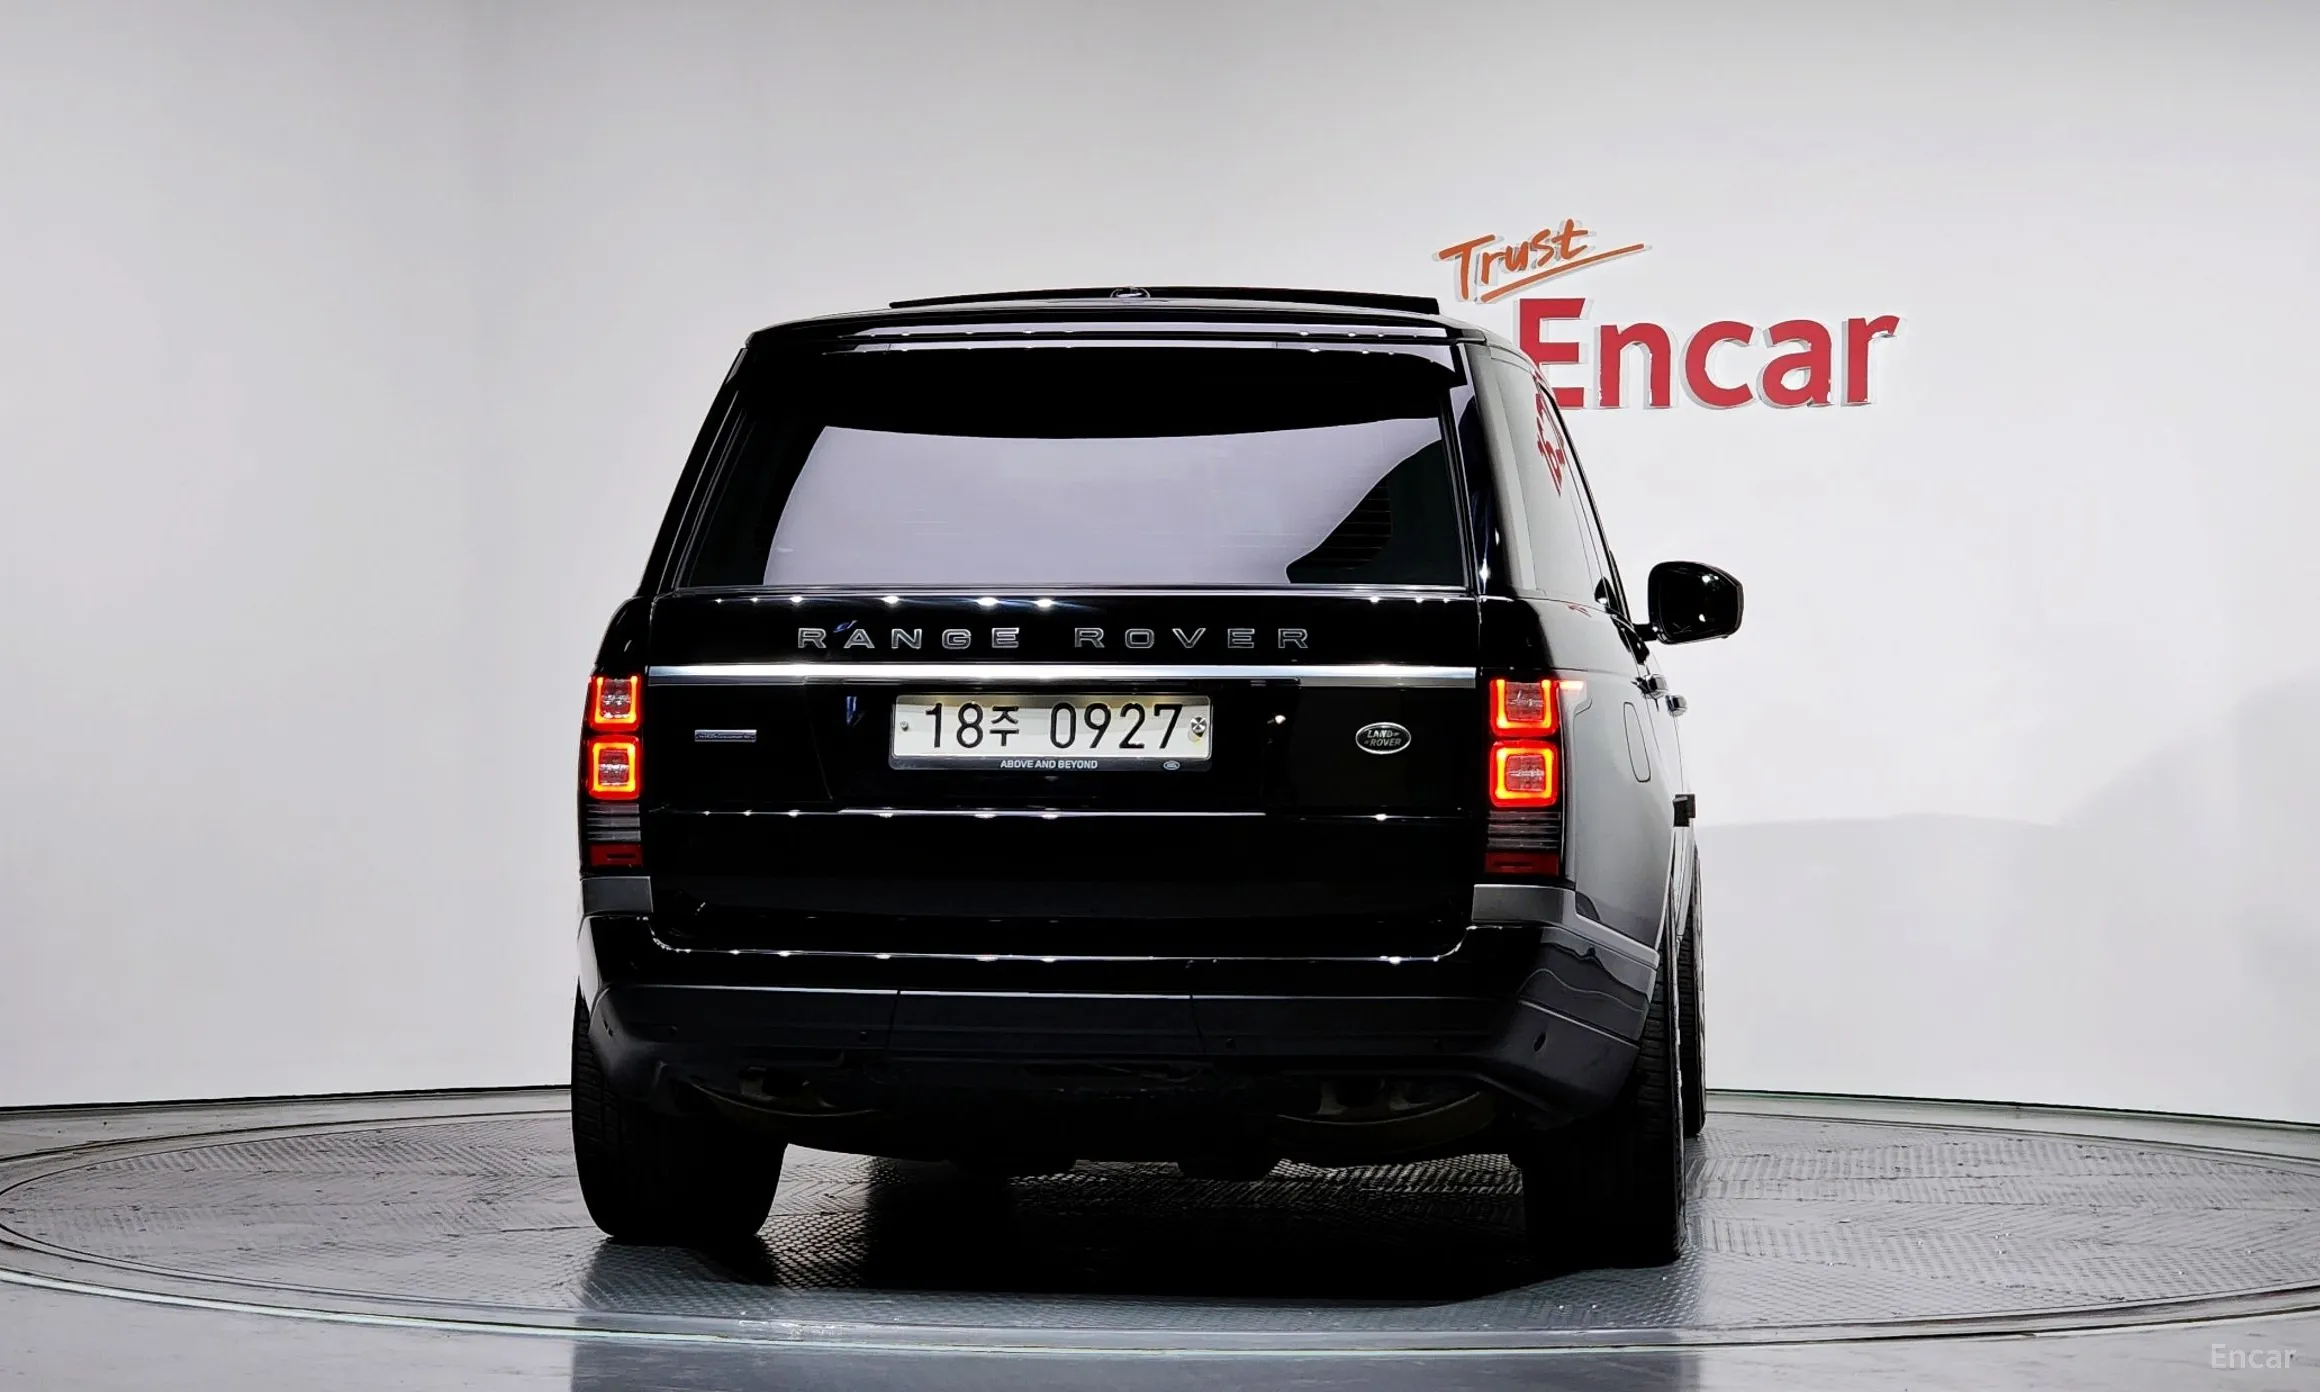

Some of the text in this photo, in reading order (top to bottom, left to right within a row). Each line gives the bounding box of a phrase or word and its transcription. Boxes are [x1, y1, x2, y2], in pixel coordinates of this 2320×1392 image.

[1438, 218, 1590, 301] Trust
[1518, 297, 1901, 409] Encar
[797, 626, 1309, 650] RANGE ROVER
[924, 702, 1184, 750] 18주 0927
[1000, 759, 1098, 769] ABOVE AND BEYOND
